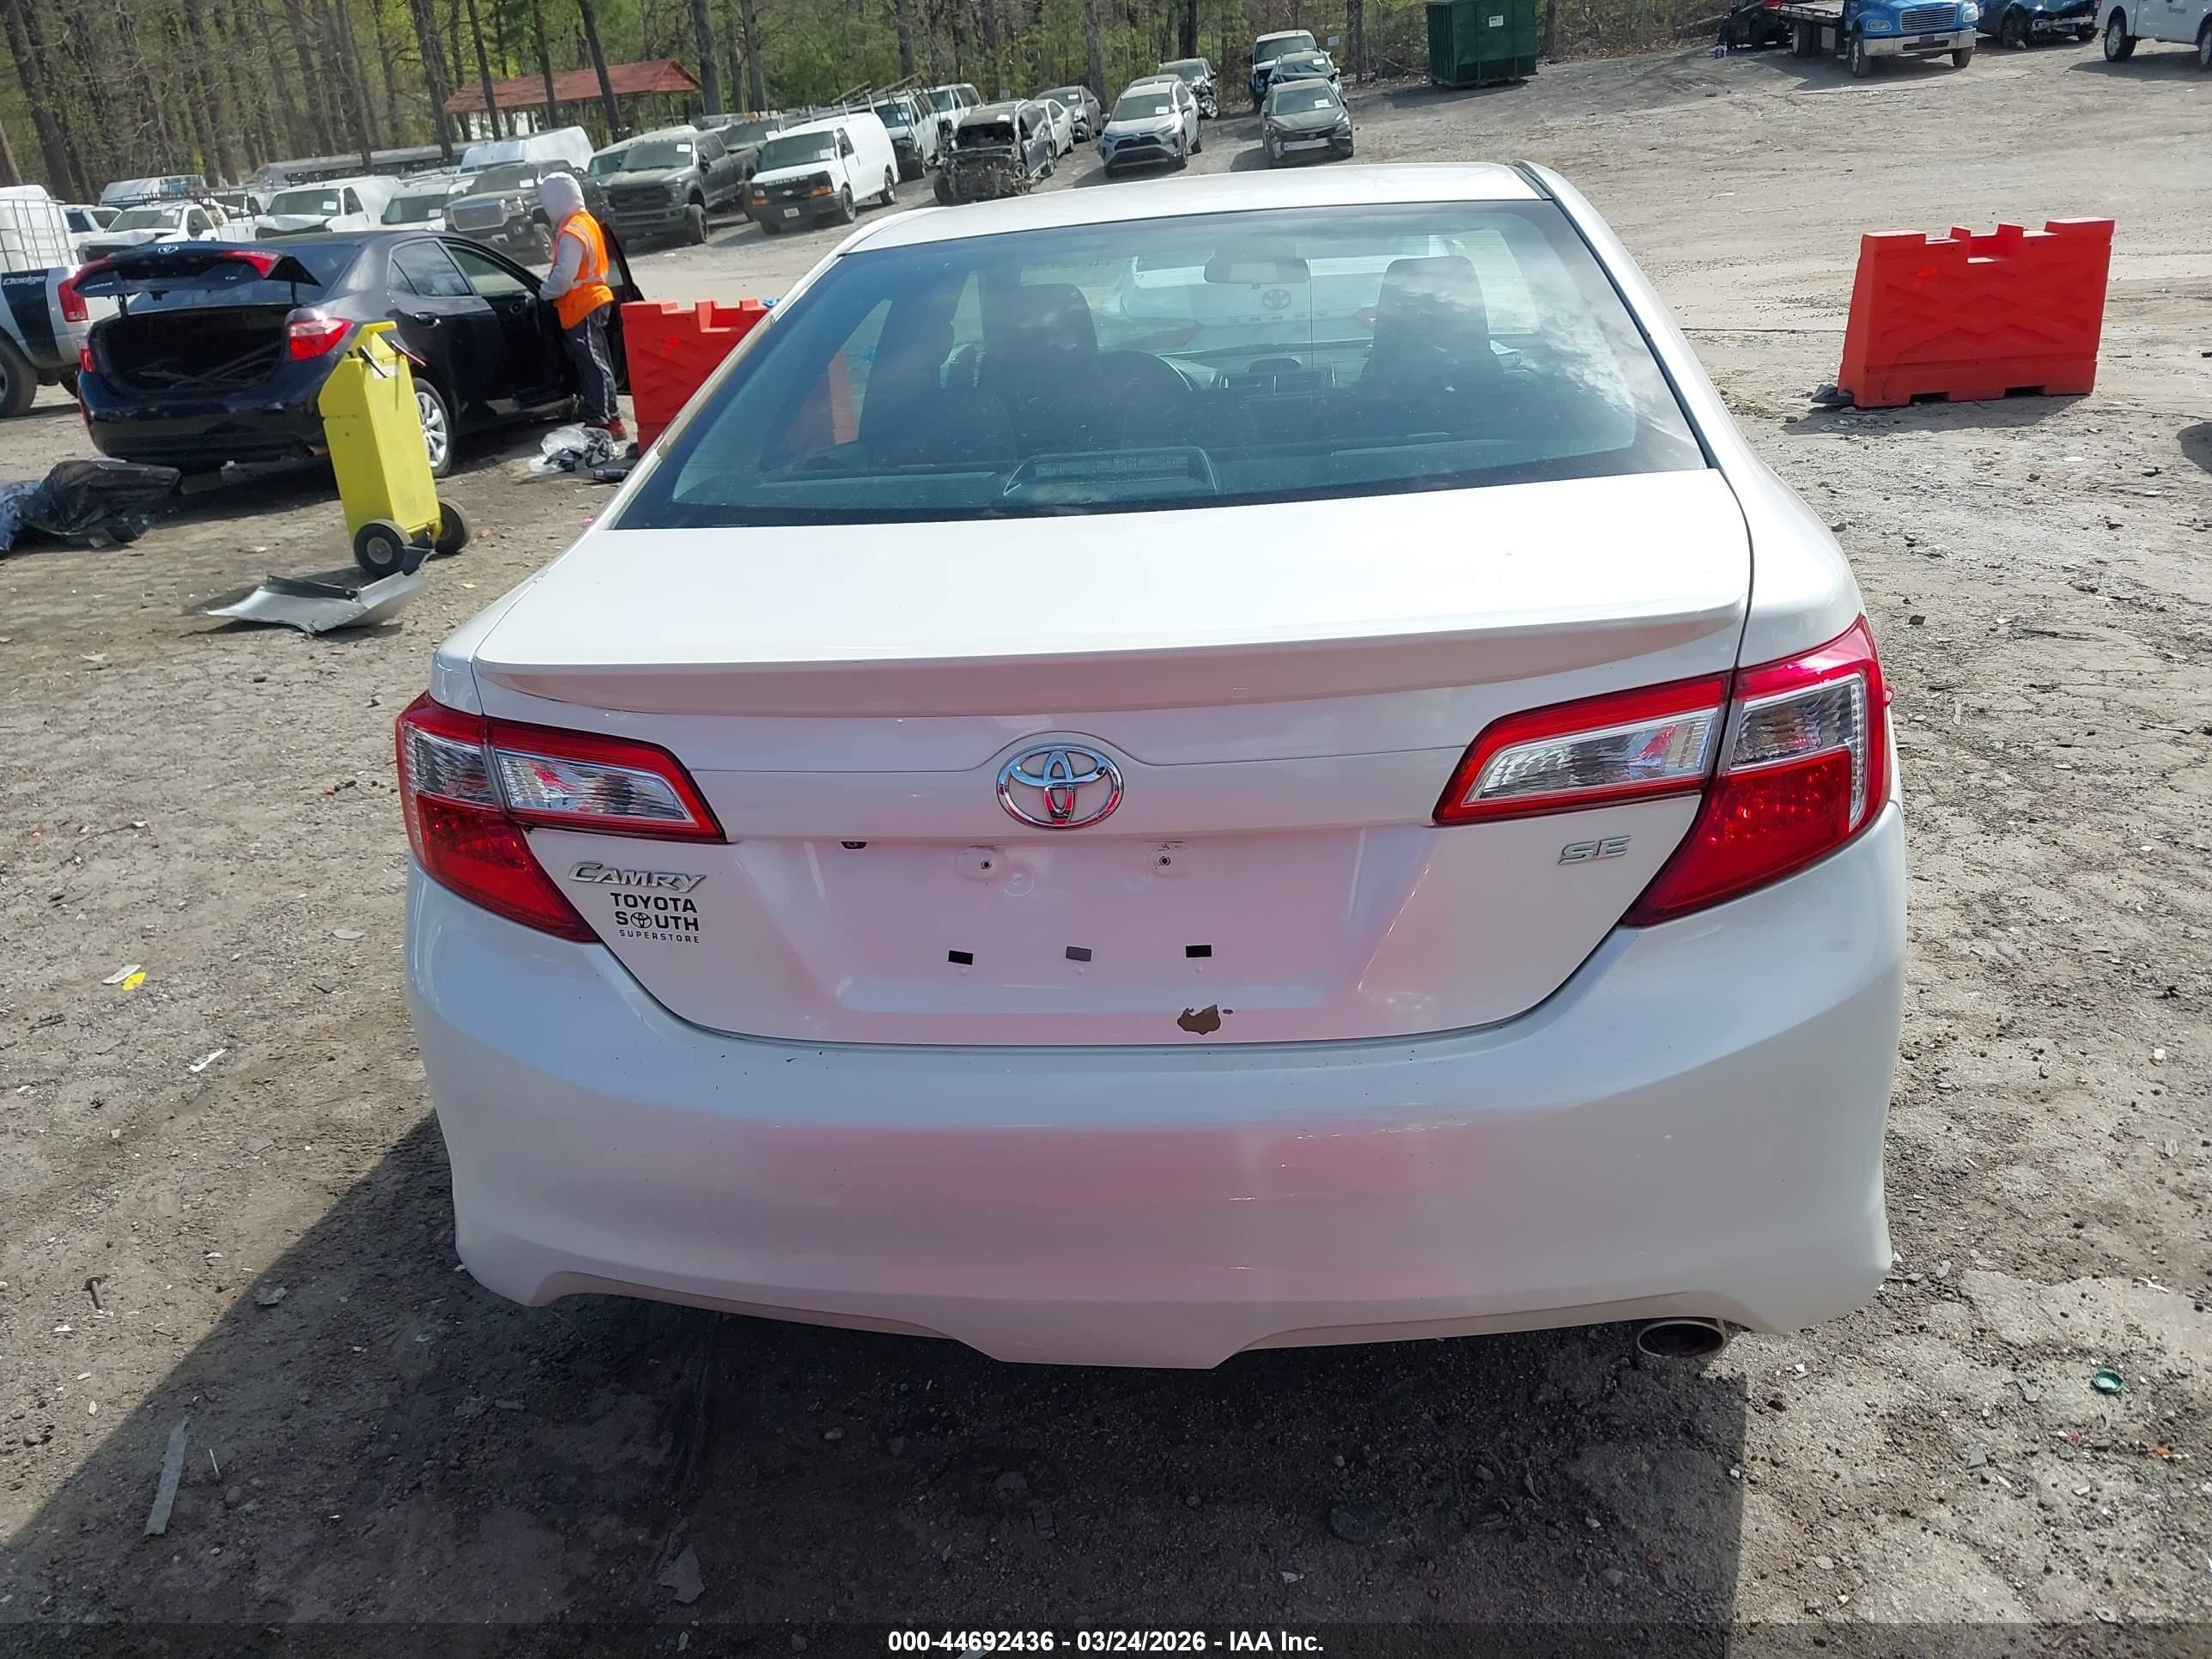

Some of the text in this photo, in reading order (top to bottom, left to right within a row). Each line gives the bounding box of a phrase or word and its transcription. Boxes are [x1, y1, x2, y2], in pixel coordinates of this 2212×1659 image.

[3, 276, 46, 286] Dodge
[1557, 836, 1632, 865] SE
[568, 861, 707, 893] CAMRY
[610, 891, 698, 914] TOYOTA
[618, 929, 701, 944] SUPERSTORE
